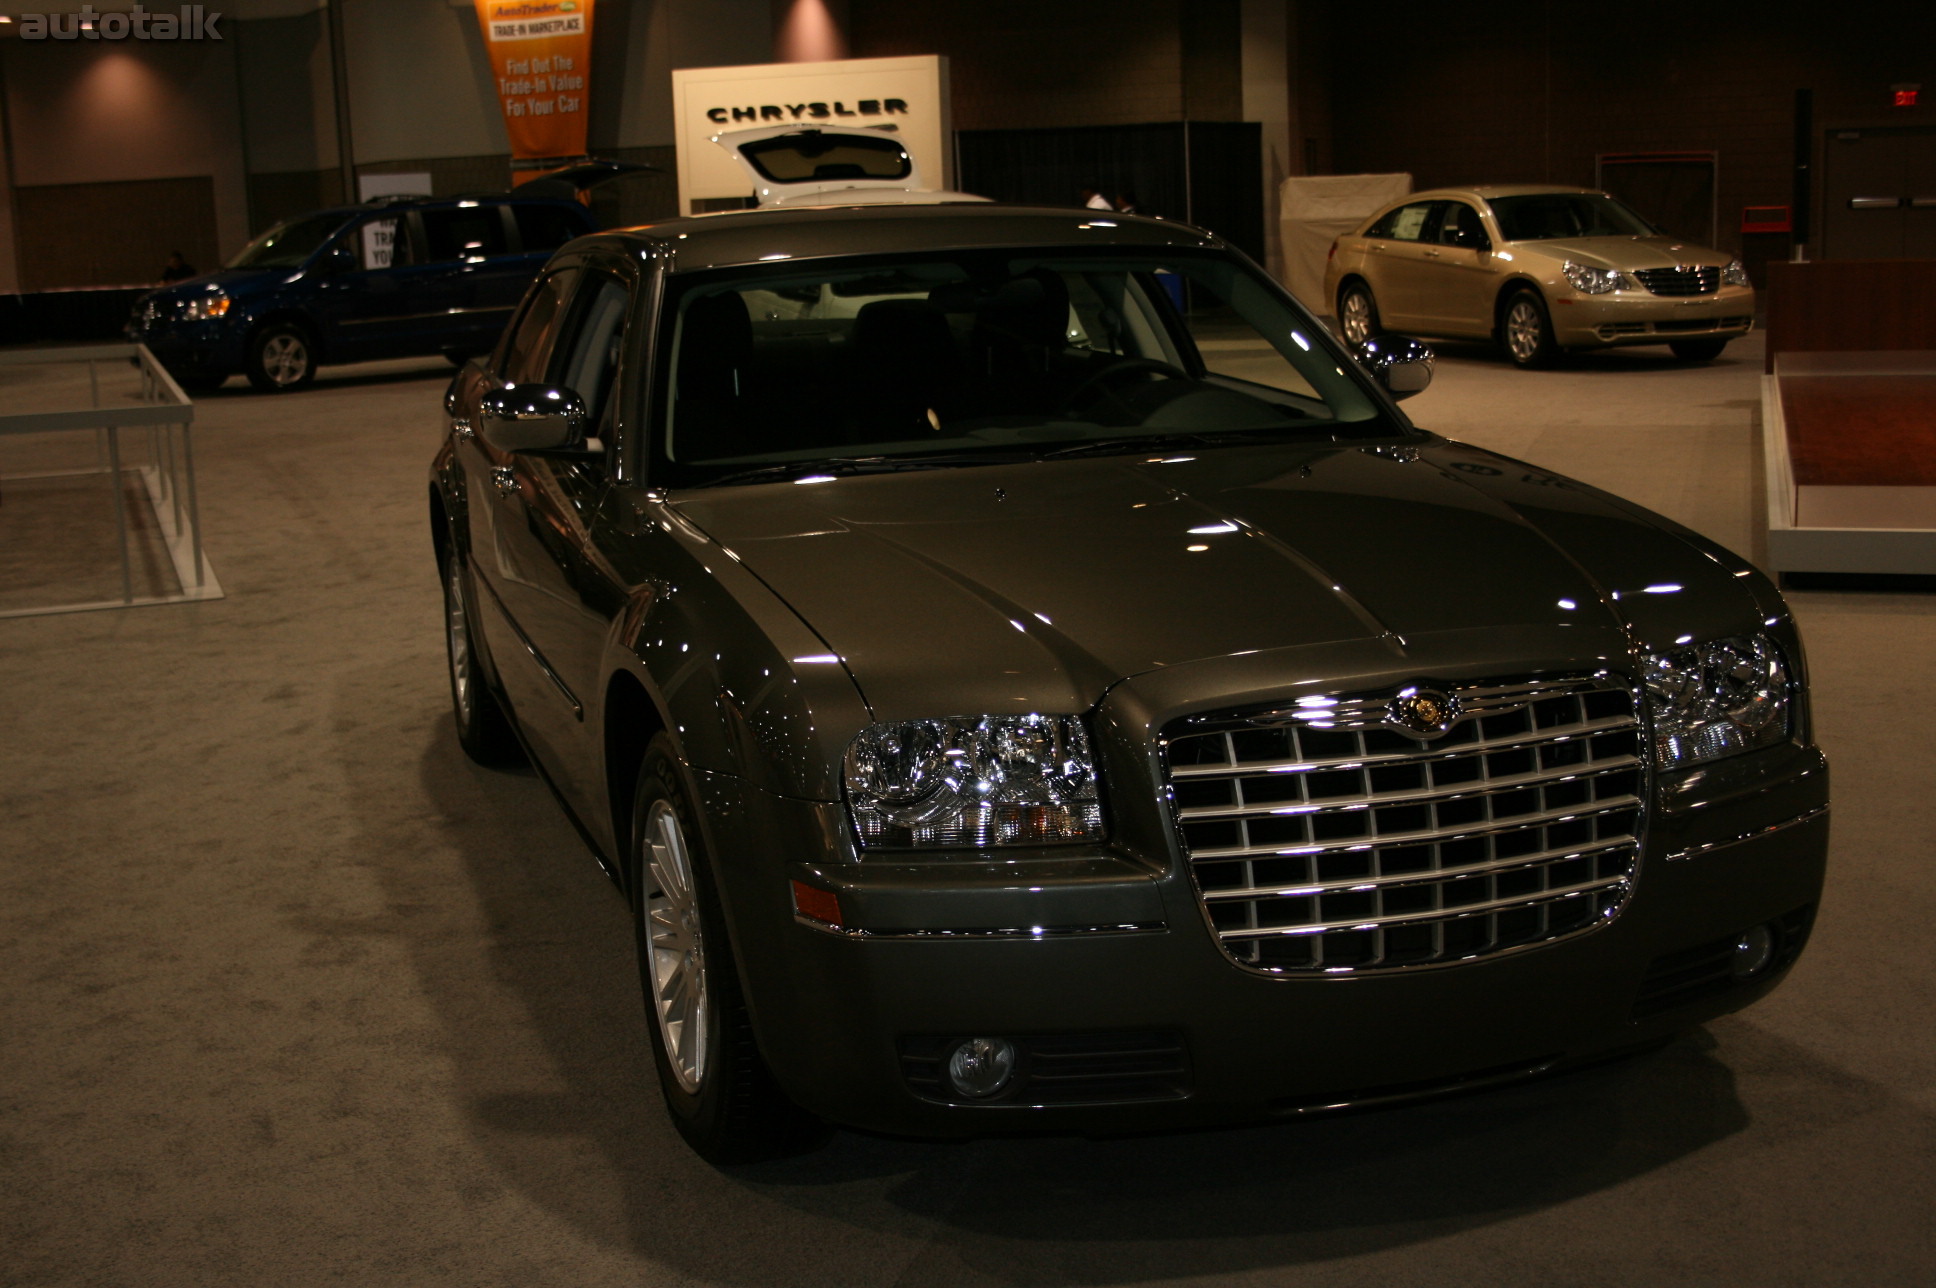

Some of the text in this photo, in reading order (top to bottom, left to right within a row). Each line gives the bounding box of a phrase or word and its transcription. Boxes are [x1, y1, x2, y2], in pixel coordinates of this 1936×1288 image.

[506, 55, 573, 75] Find Out The
[500, 74, 583, 95] Trade-In Value
[506, 95, 579, 117] For Your Car
[707, 99, 908, 123] CHRYSLER
